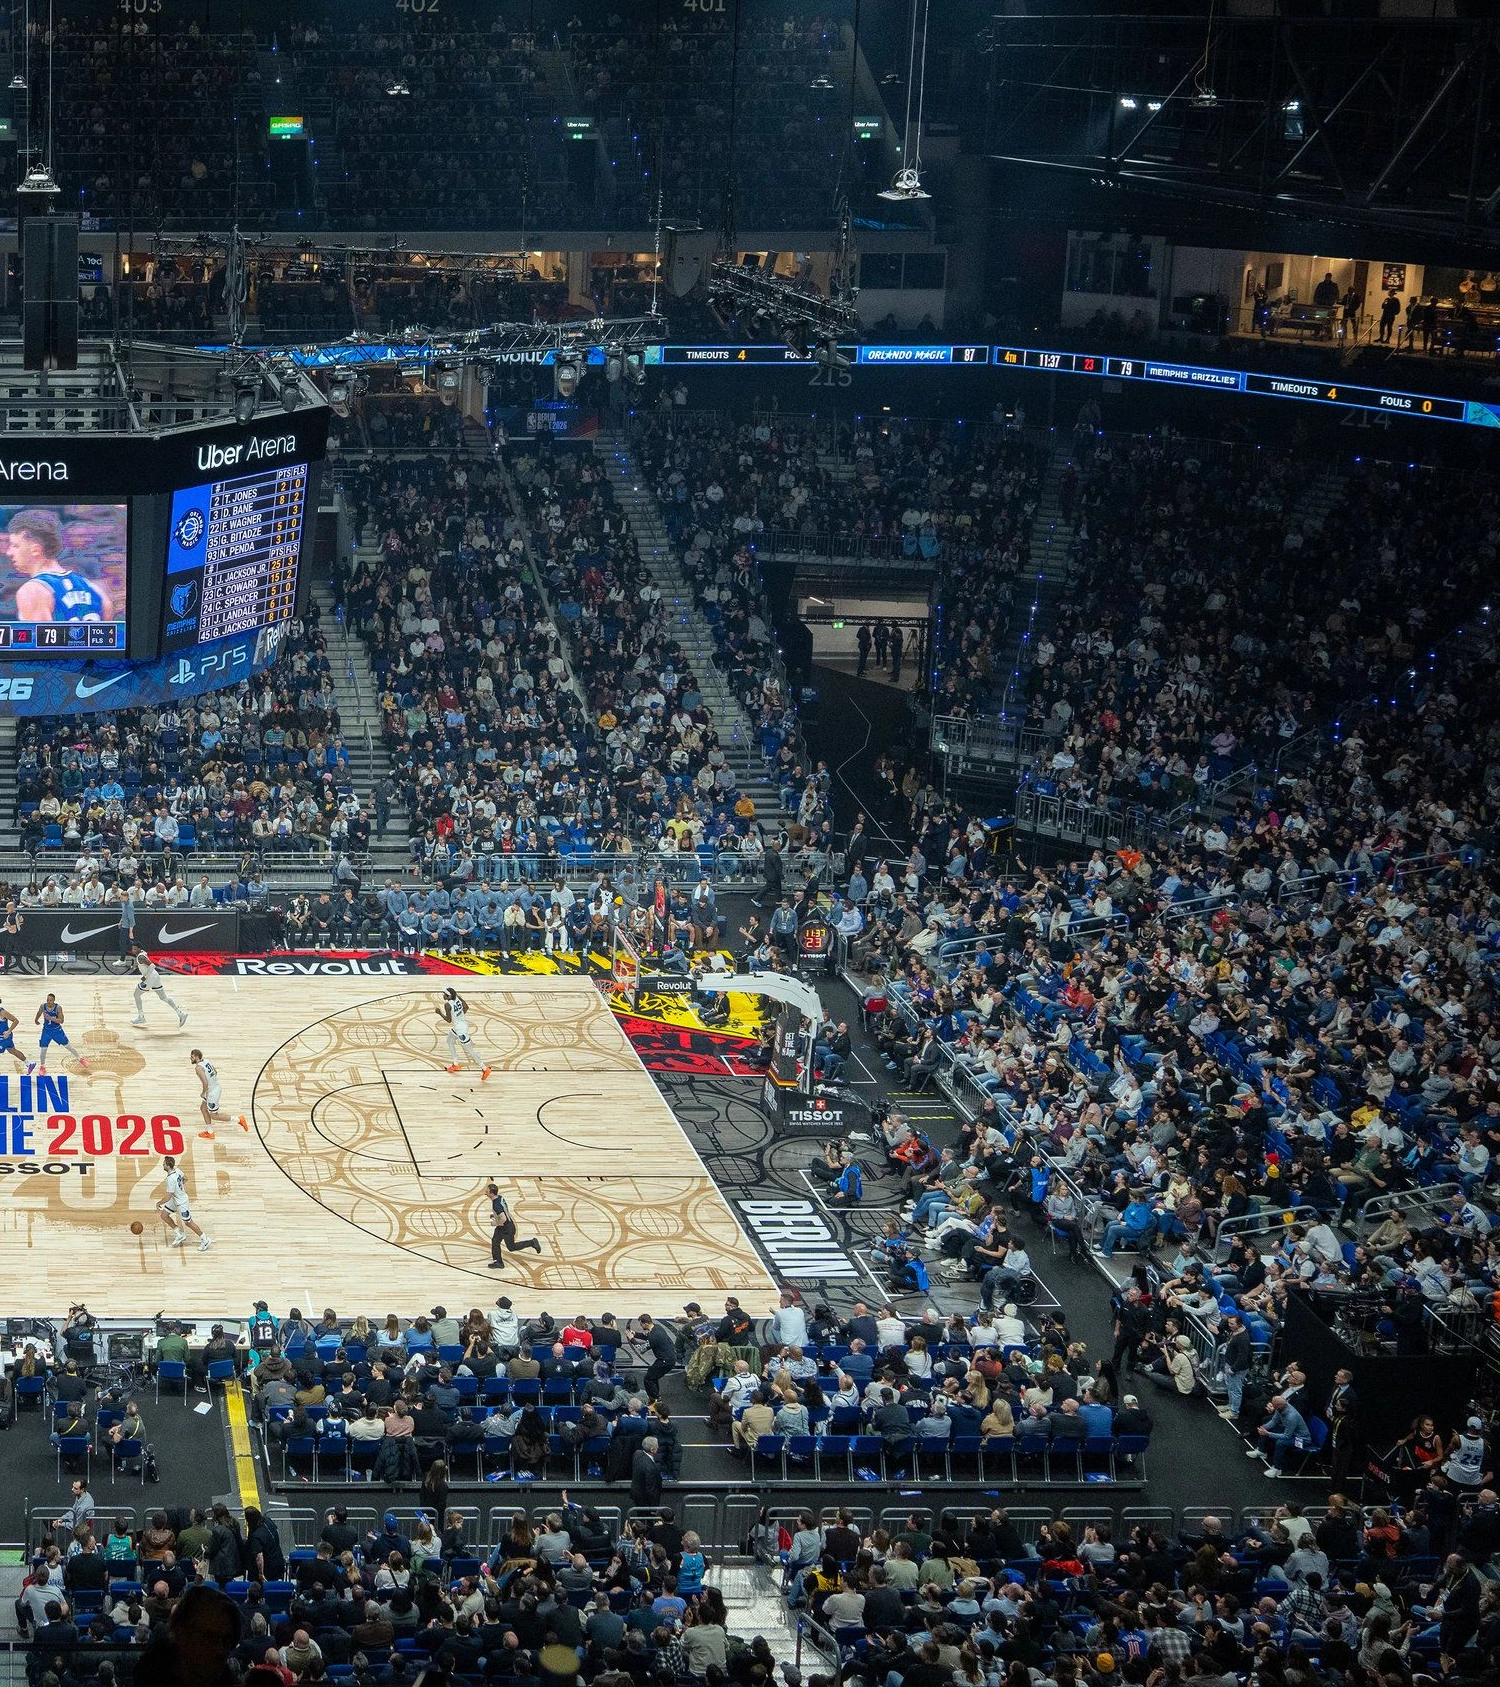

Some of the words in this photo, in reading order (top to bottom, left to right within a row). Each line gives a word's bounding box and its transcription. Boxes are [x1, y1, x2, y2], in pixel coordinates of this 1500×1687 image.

[686, 350, 729, 360] TIMEOUTS
[737, 350, 747, 361] 4
[784, 351, 812, 359] FOS
[808, 366, 852, 387] 215
[867, 350, 912, 360] ORLANDO
[914, 350, 946, 360] MAGIC
[964, 348, 975, 361] 87
[1004, 351, 1017, 363] 4TH
[1039, 353, 1061, 368] 11:37
[1084, 358, 1095, 371] 23
[1121, 361, 1132, 376] 79
[1150, 367, 1188, 379] MEMPHIS
[1191, 372, 1236, 385] GRIZZLIES
[1271, 381, 1318, 396] TIMEOUTS
[1327, 387, 1338, 400] 4
[1380, 396, 1412, 409] FOULS
[1422, 400, 1432, 413] 0
[198, 444, 243, 470] Uber
[246, 435, 295, 461] Arena
[207, 577, 213, 586] 8
[216, 574, 223, 585] J.
[225, 566, 256, 582] JACKSON
[257, 563, 268, 574] JR.
[204, 591, 214, 601] 23
[216, 587, 224, 597] C.
[225, 578, 258, 595] COWARD
[203, 604, 213, 614] 24
[215, 601, 223, 610] C.
[223, 591, 258, 608] SPENCER
[201, 617, 211, 627] 31
[213, 614, 221, 624] J.
[222, 605, 257, 622] LANDALE
[18, 632, 27, 641] 23
[45, 629, 57, 644] 79
[200, 630, 210, 640] 45
[213, 627, 221, 636] G.
[222, 617, 258, 635] JACKSON
[201, 645, 246, 675] PS5
[806, 929, 826, 937] 11:37
[806, 938, 821, 948] 23
[235, 958, 408, 975] Revolut
[657, 981, 691, 990] Revolut
[454, 1000, 463, 1012] 45
[784, 1040, 794, 1048] THE
[785, 1032, 795, 1040] GET
[789, 1110, 843, 1121] TISSOT
[47, 1115, 185, 1155] 2026
[738, 1200, 860, 1276] BERLIN
[259, 1327, 273, 1340] 12
